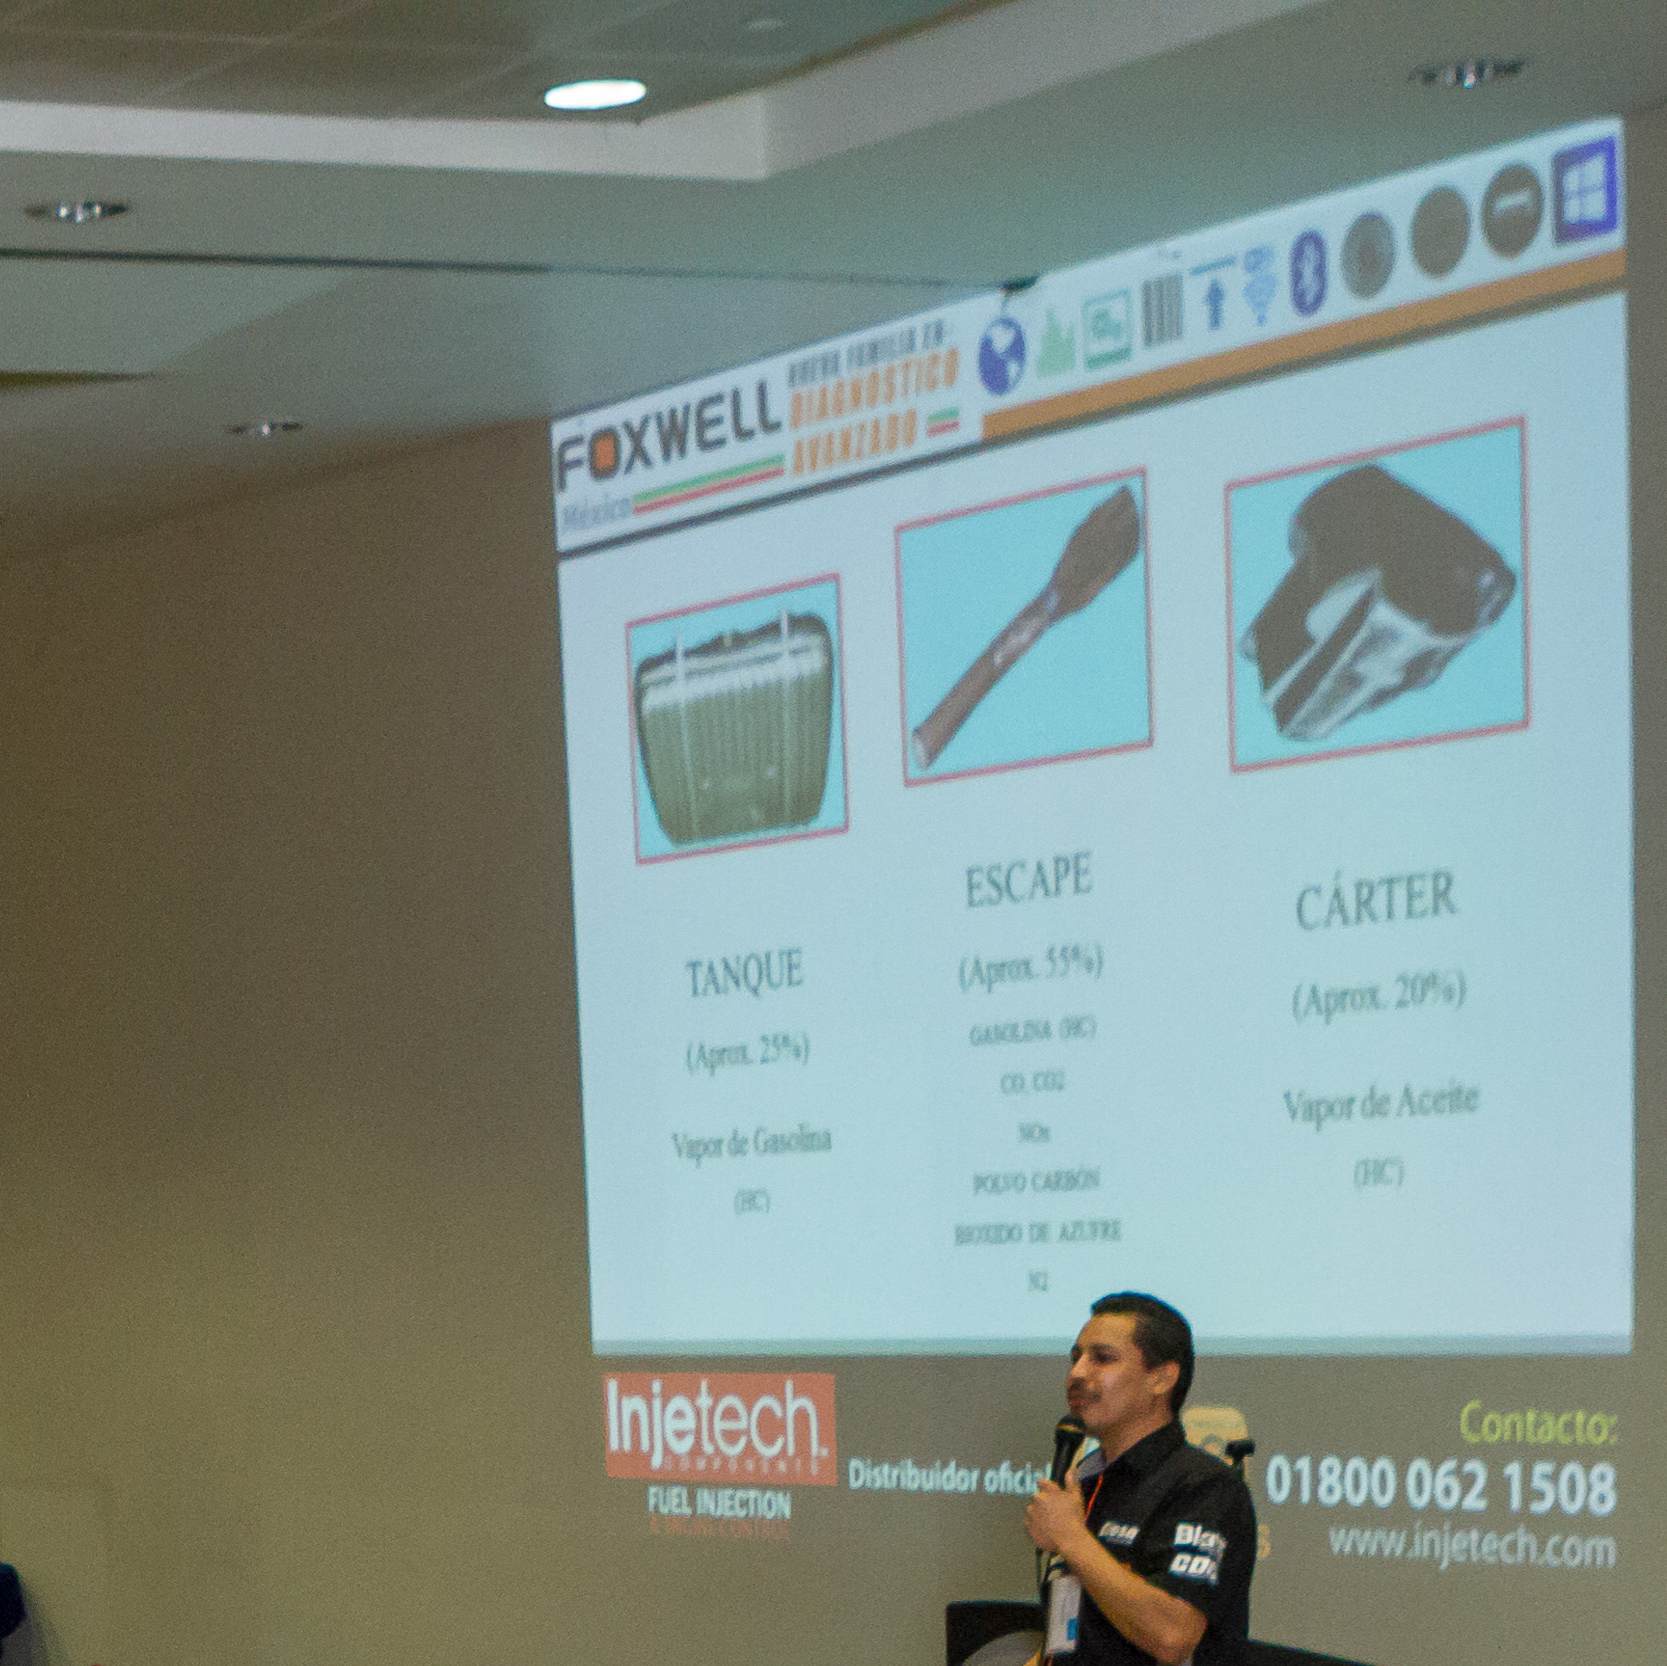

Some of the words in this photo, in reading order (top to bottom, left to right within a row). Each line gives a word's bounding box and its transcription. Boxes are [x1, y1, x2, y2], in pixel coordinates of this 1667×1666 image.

[557, 379, 782, 493] FOXWELL
[966, 849, 1094, 908] ESCAPE
[1296, 866, 1457, 932] CÁRTER
[684, 947, 803, 998] TANQUE
[1283, 1087, 1357, 1134] Vapor
[1360, 1082, 1393, 1120] de
[1395, 1076, 1482, 1119] Aceite
[671, 1130, 724, 1170] Vapor
[726, 1126, 749, 1157] de
[752, 1122, 833, 1156] Gasolina
[647, 1484, 693, 1518] FUEL
[695, 1486, 793, 1521] INJECTION
[847, 1456, 981, 1494] Distribuidor
[1266, 1452, 1398, 1510] 01800
[1405, 1455, 1490, 1514] 062
[1501, 1458, 1618, 1518] 1508
[1328, 1519, 1618, 1573] www.injetech.com
